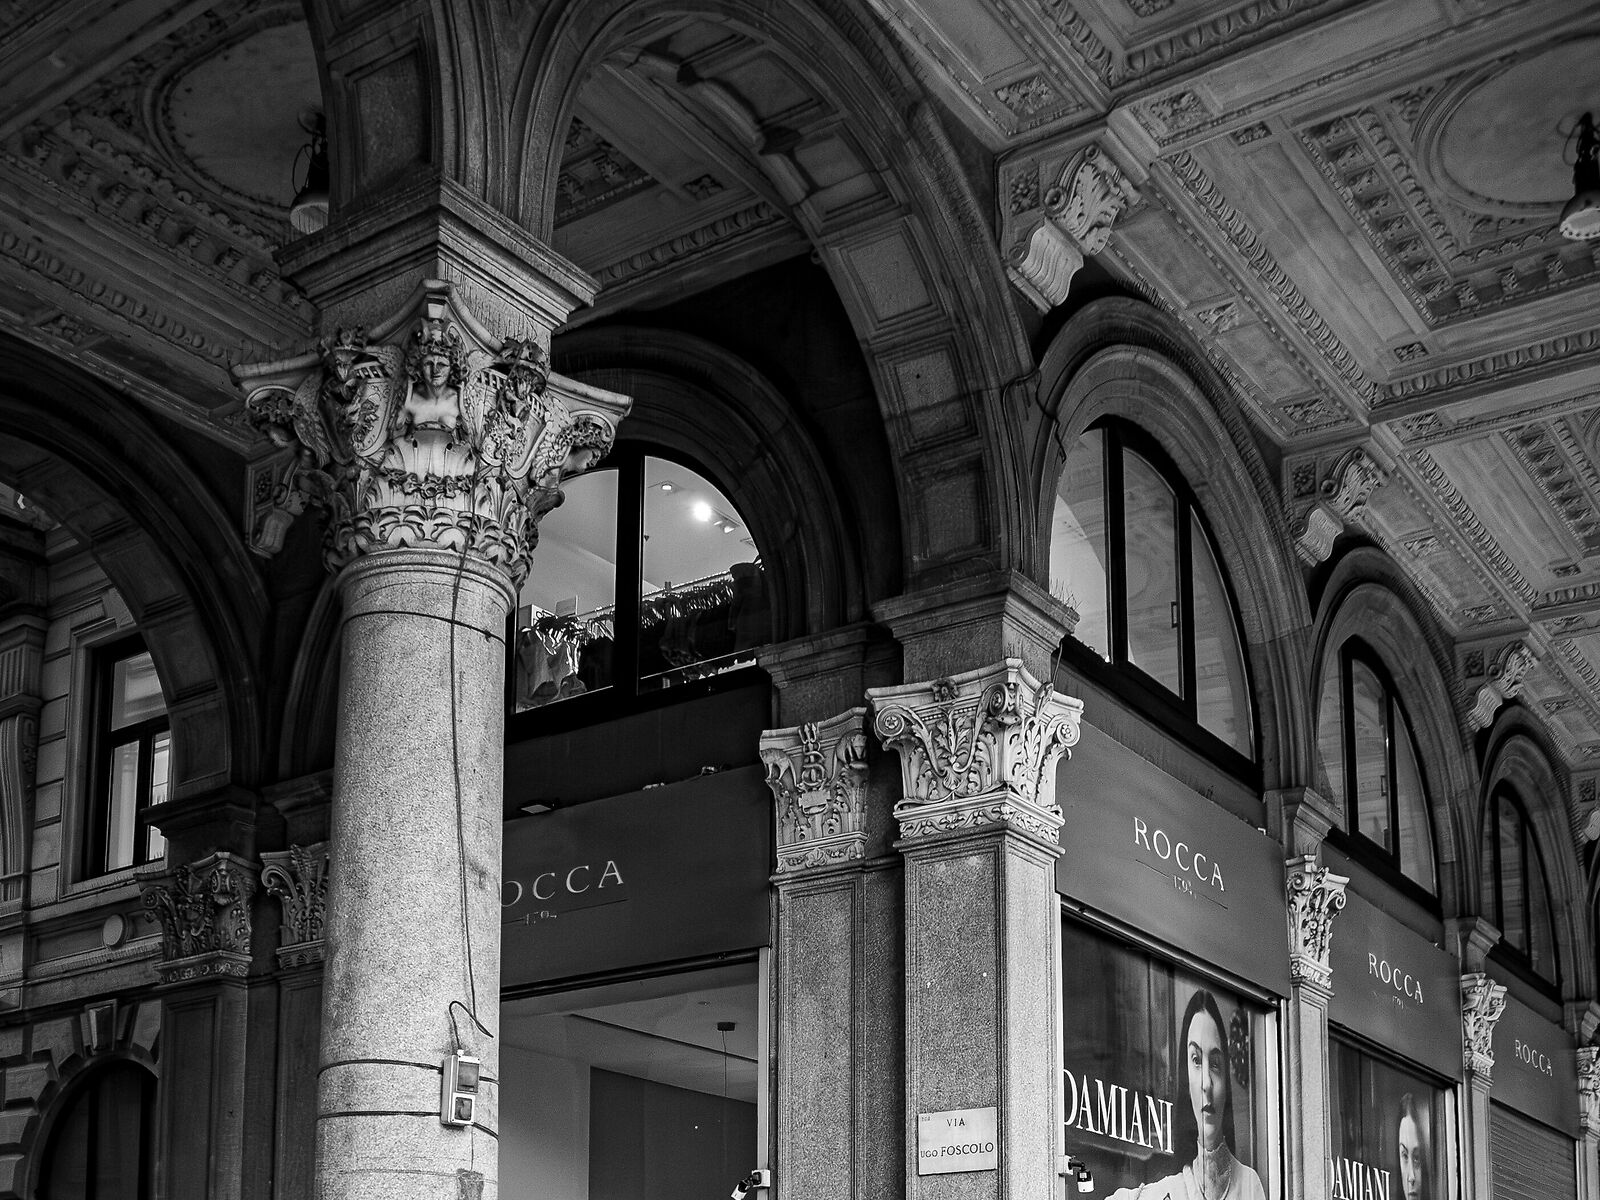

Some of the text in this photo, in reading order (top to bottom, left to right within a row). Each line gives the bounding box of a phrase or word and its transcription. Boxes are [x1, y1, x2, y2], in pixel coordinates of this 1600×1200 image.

[1134, 817, 1225, 892] ROCCA
[501, 860, 625, 908] OCCA
[1368, 952, 1424, 1004] ROCCA
[1515, 1039, 1553, 1077] ROCCA
[946, 1117, 966, 1127] VIA
[1063, 1068, 1175, 1155] DAMIANI
[920, 1142, 994, 1158] UGO FOSCOLO
